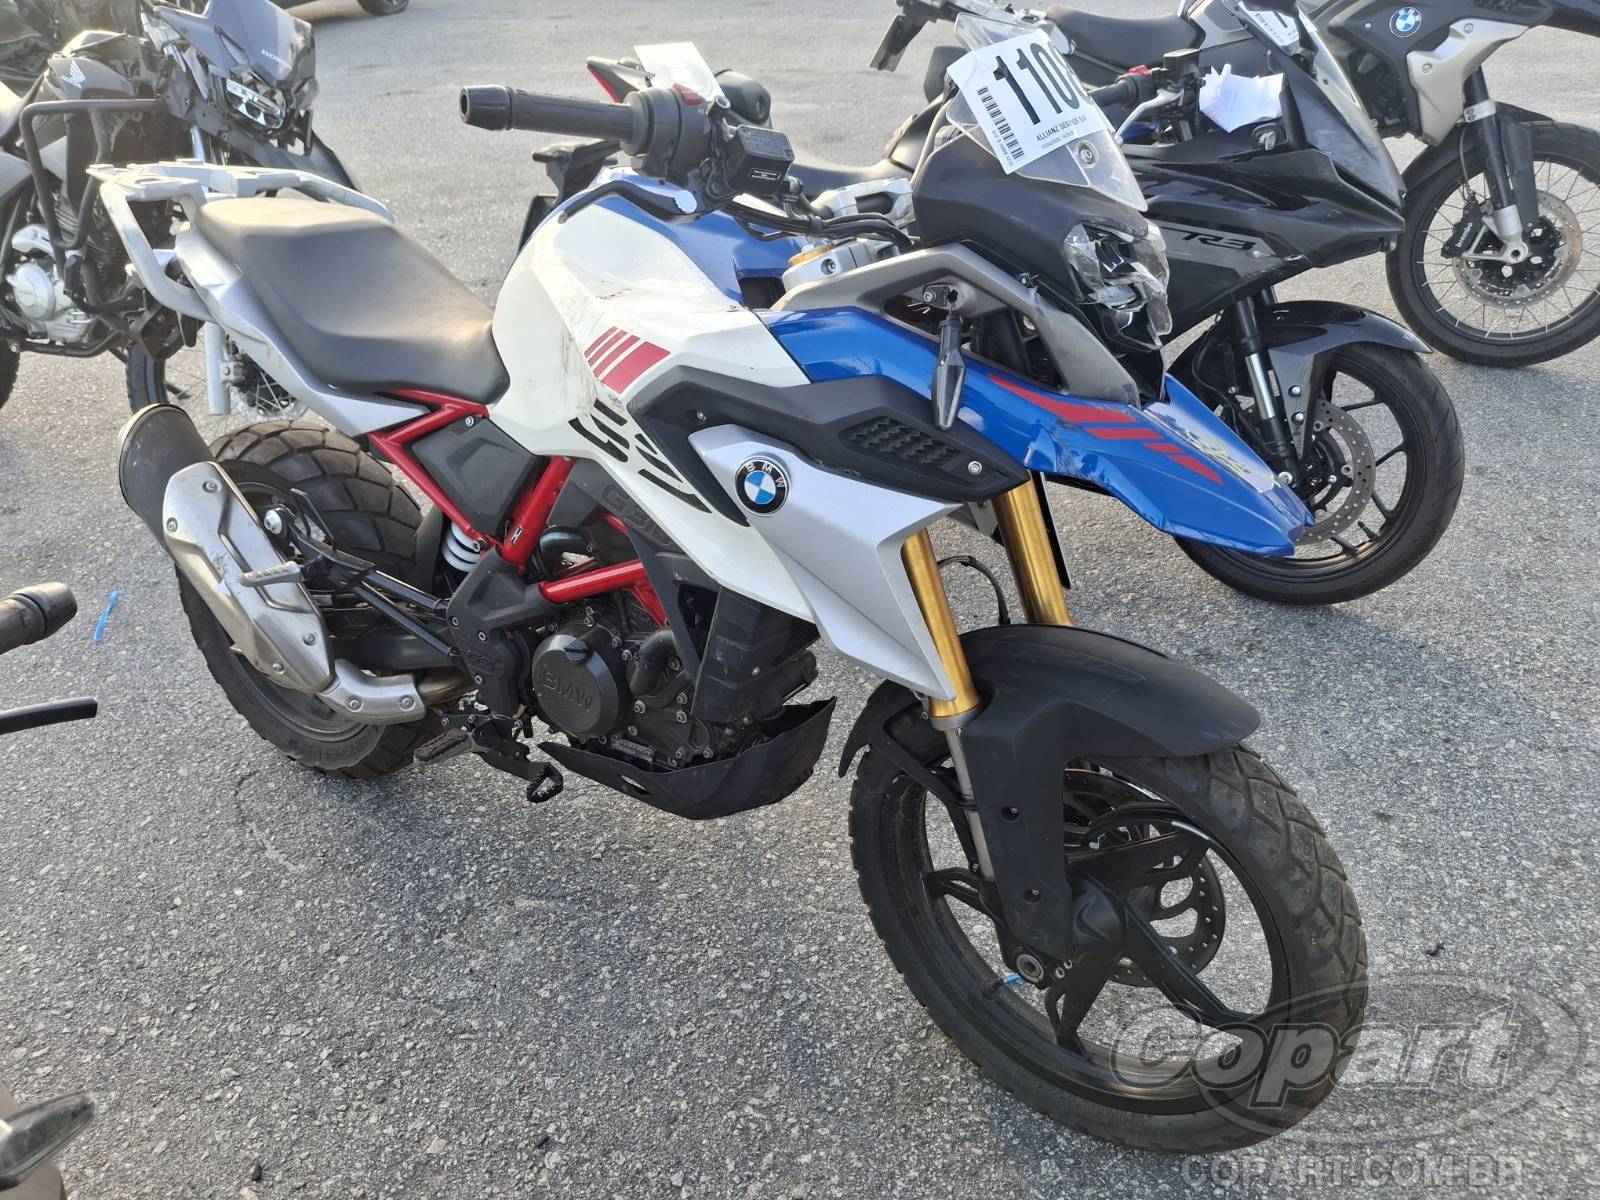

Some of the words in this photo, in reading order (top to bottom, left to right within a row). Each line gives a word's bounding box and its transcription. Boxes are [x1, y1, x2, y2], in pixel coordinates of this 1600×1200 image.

[1036, 125, 1060, 141] ALLIANZ
[745, 461, 786, 488] BMW
[542, 664, 594, 711] BMW
